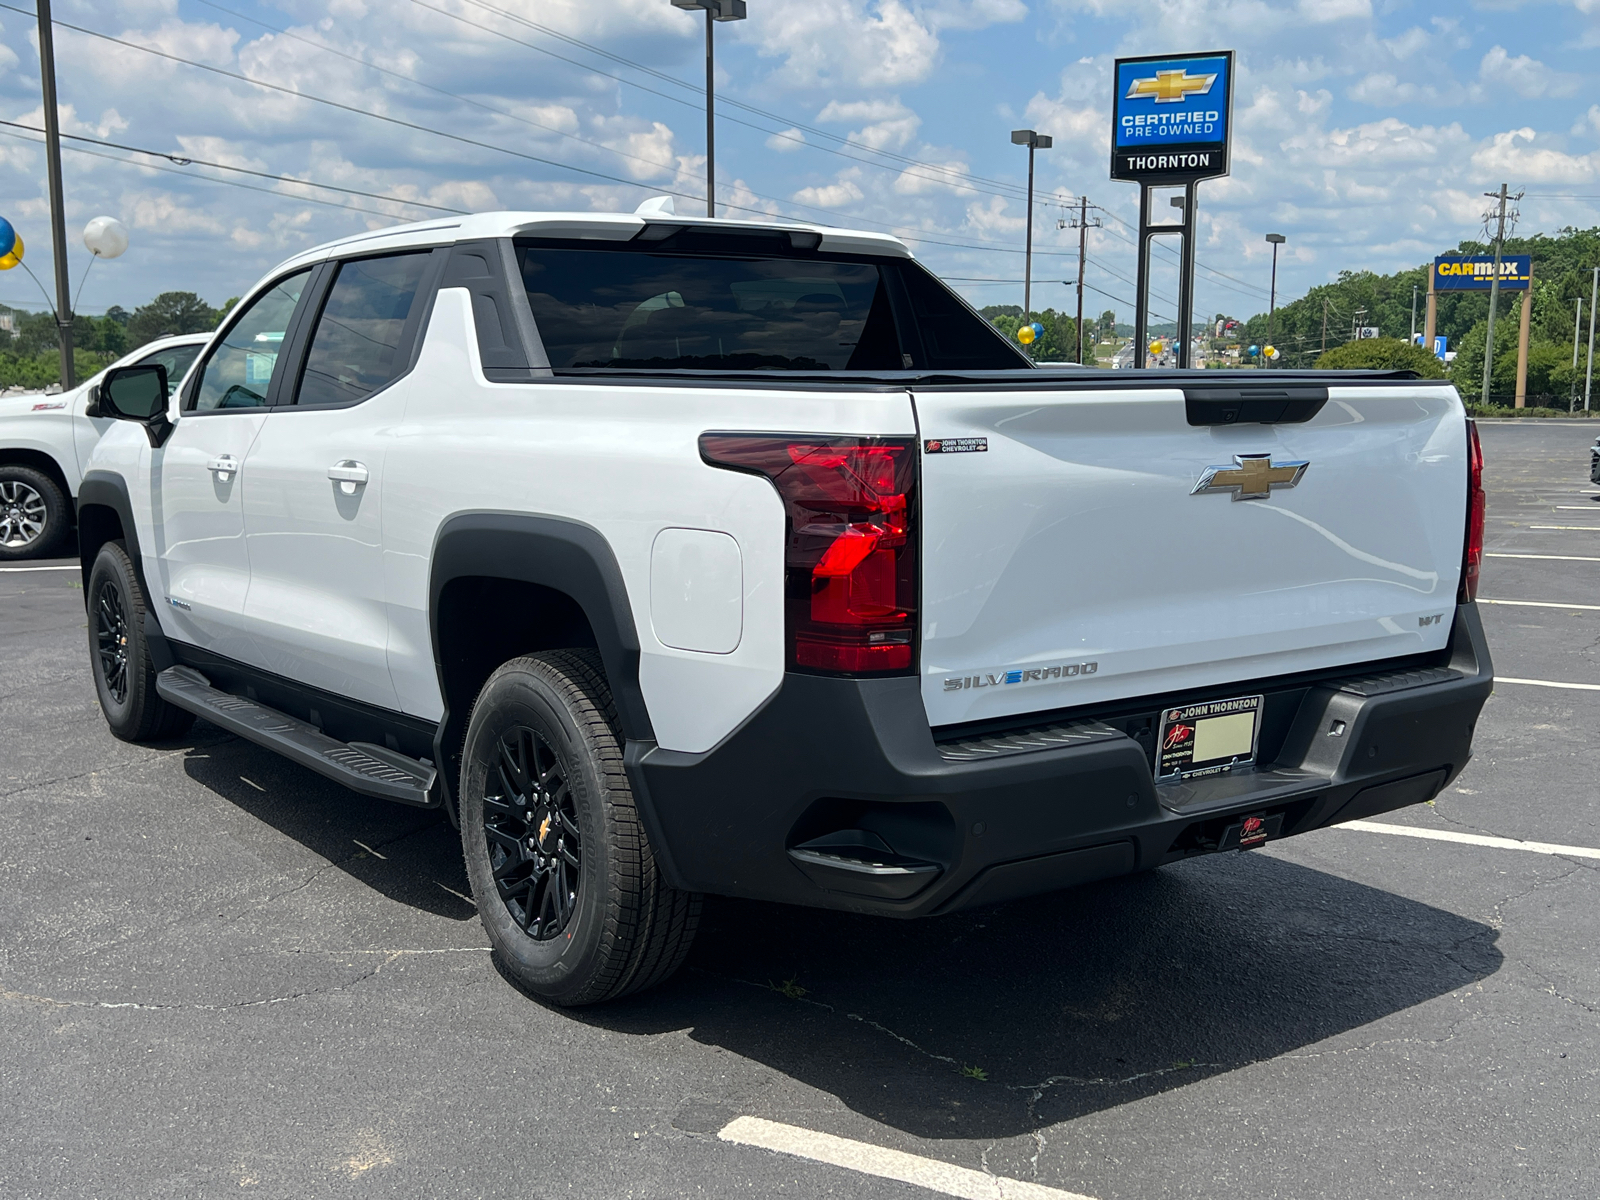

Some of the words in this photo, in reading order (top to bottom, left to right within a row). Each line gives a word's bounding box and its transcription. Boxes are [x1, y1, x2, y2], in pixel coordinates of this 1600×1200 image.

[1121, 111, 1219, 126] CERTIFIED
[1125, 123, 1214, 138] PRE-OWNED
[1127, 153, 1210, 170] THORNTON
[943, 661, 1098, 692] SILVERADO
[1184, 705, 1208, 718] JOHN
[1209, 698, 1257, 712] THORNTON
[1192, 768, 1222, 778] CHEVROLET
